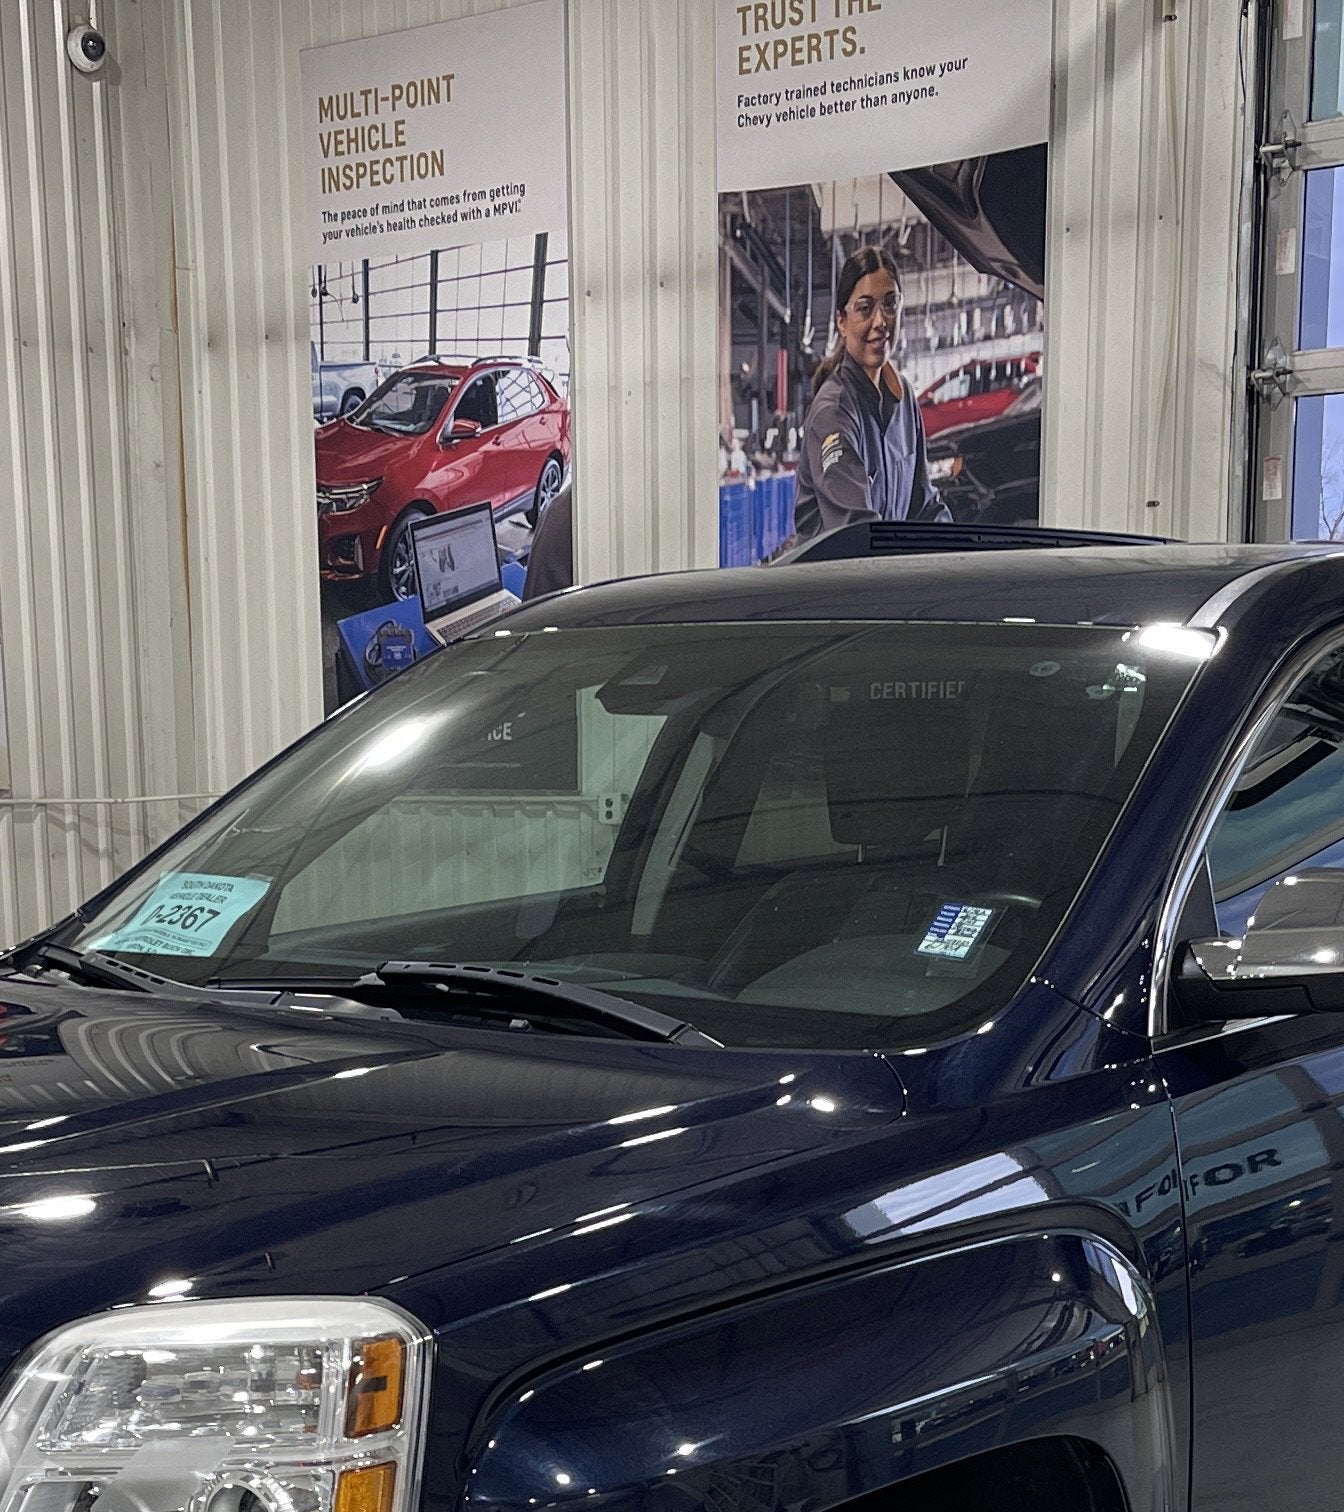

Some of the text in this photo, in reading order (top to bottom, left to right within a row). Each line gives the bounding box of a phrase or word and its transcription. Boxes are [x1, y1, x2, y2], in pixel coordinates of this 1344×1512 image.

[736, 0, 816, 36] TRUST
[738, 25, 866, 75] EXPERTS.
[318, 73, 455, 124] MULTI-POINT
[737, 57, 969, 109] Factory trained technicians know your
[737, 85, 939, 128] Chevy vehicle better than anyone.
[318, 119, 407, 159] VEHICLE
[320, 148, 446, 194] INSPECTION
[322, 182, 526, 224] The peace of mind that comes from getting
[322, 229, 342, 244] your
[345, 221, 384, 239] vehicle's
[386, 216, 416, 233] health
[418, 210, 458, 228] checked
[460, 205, 483, 222] with
[484, 207, 491, 218] a
